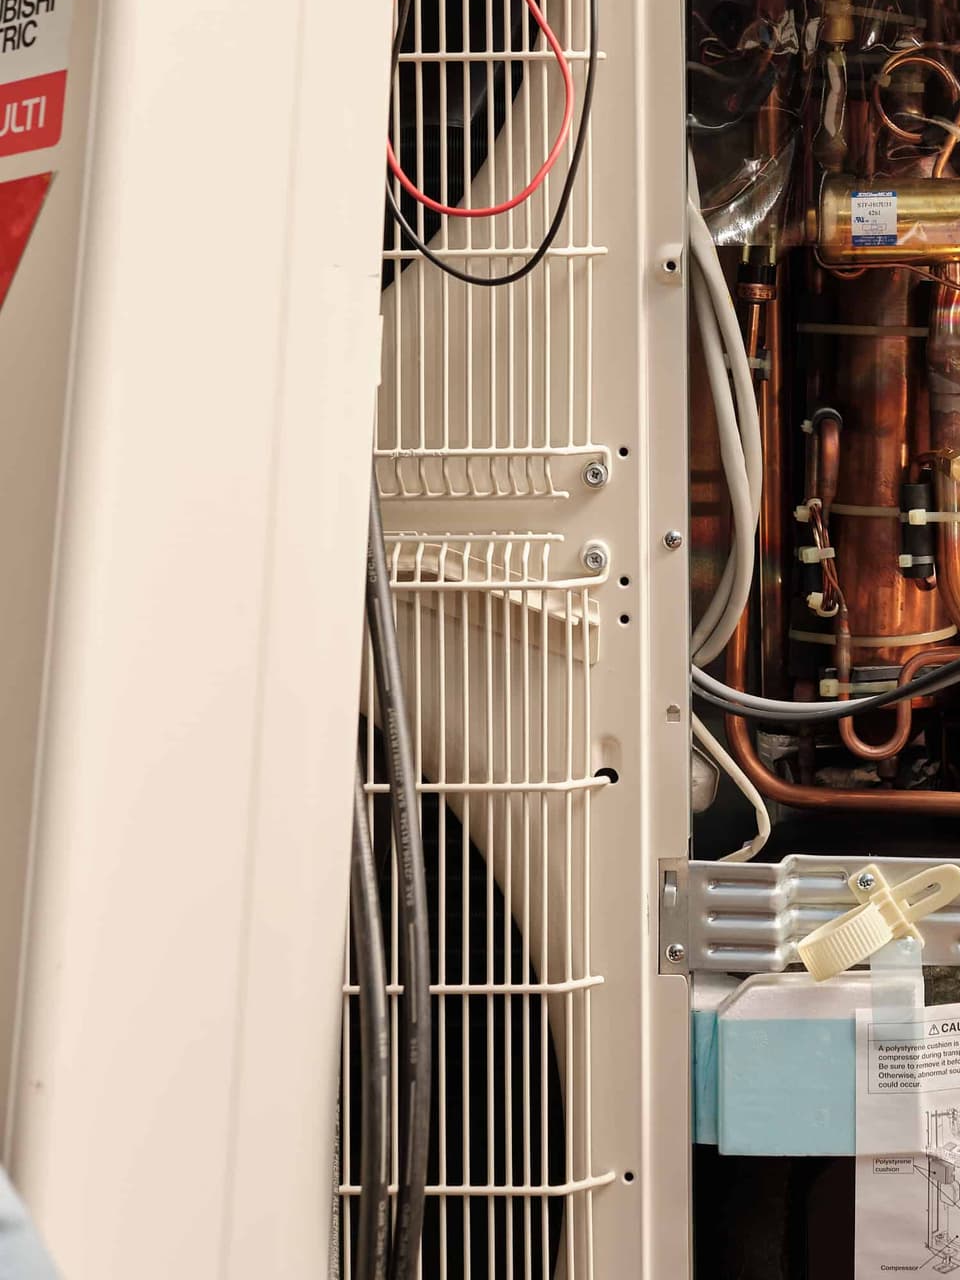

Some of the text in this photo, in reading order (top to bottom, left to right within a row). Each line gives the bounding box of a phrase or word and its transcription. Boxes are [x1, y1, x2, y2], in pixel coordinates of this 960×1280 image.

[886, 1044, 926, 1053] polystyrene
[927, 1041, 951, 1050] cushion
[878, 1054, 920, 1062] compressor
[921, 1052, 942, 1060] during
[878, 1072, 916, 1080] Otherwise,
[917, 1069, 948, 1079] abnormal
[880, 1264, 919, 1272] Compressor
